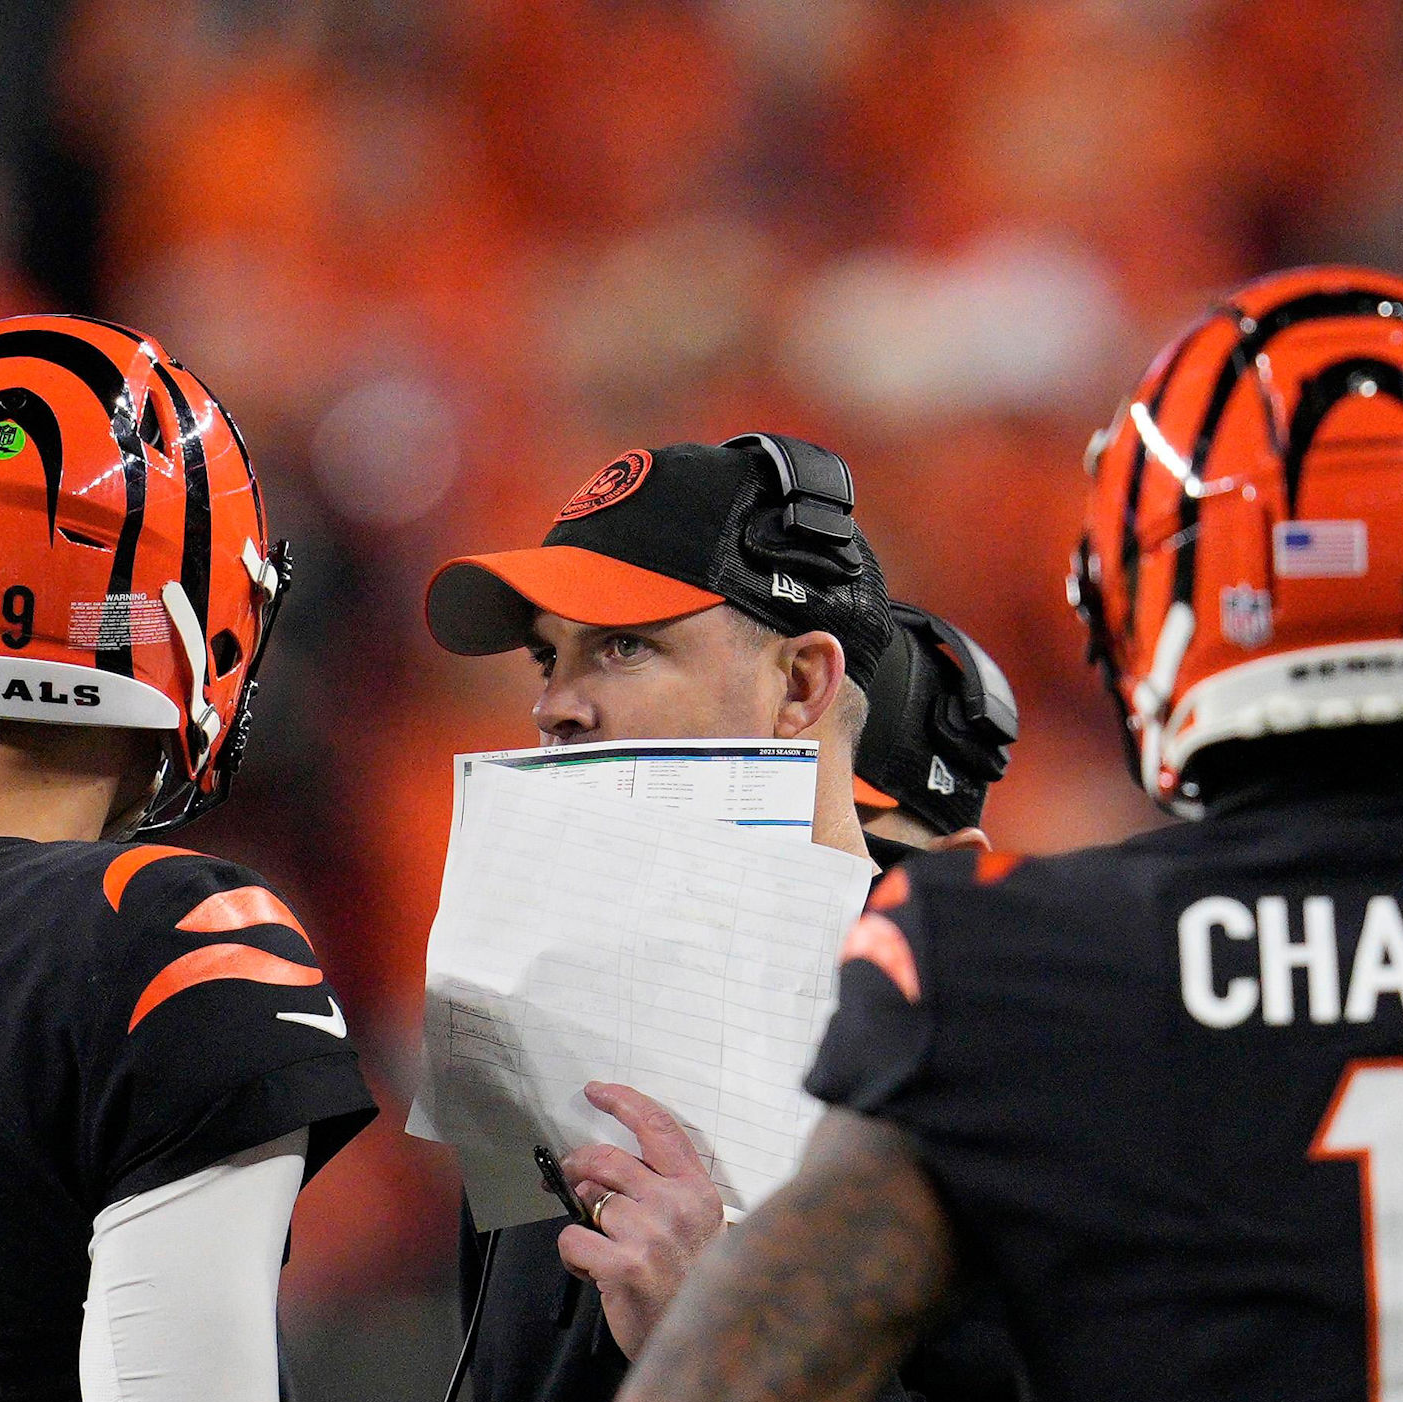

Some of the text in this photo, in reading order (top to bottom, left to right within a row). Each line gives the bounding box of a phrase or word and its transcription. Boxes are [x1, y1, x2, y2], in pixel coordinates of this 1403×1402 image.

[105, 592, 148, 602] WARNING
[1, 585, 35, 650] 9
[776, 748, 801, 756] SEASON
